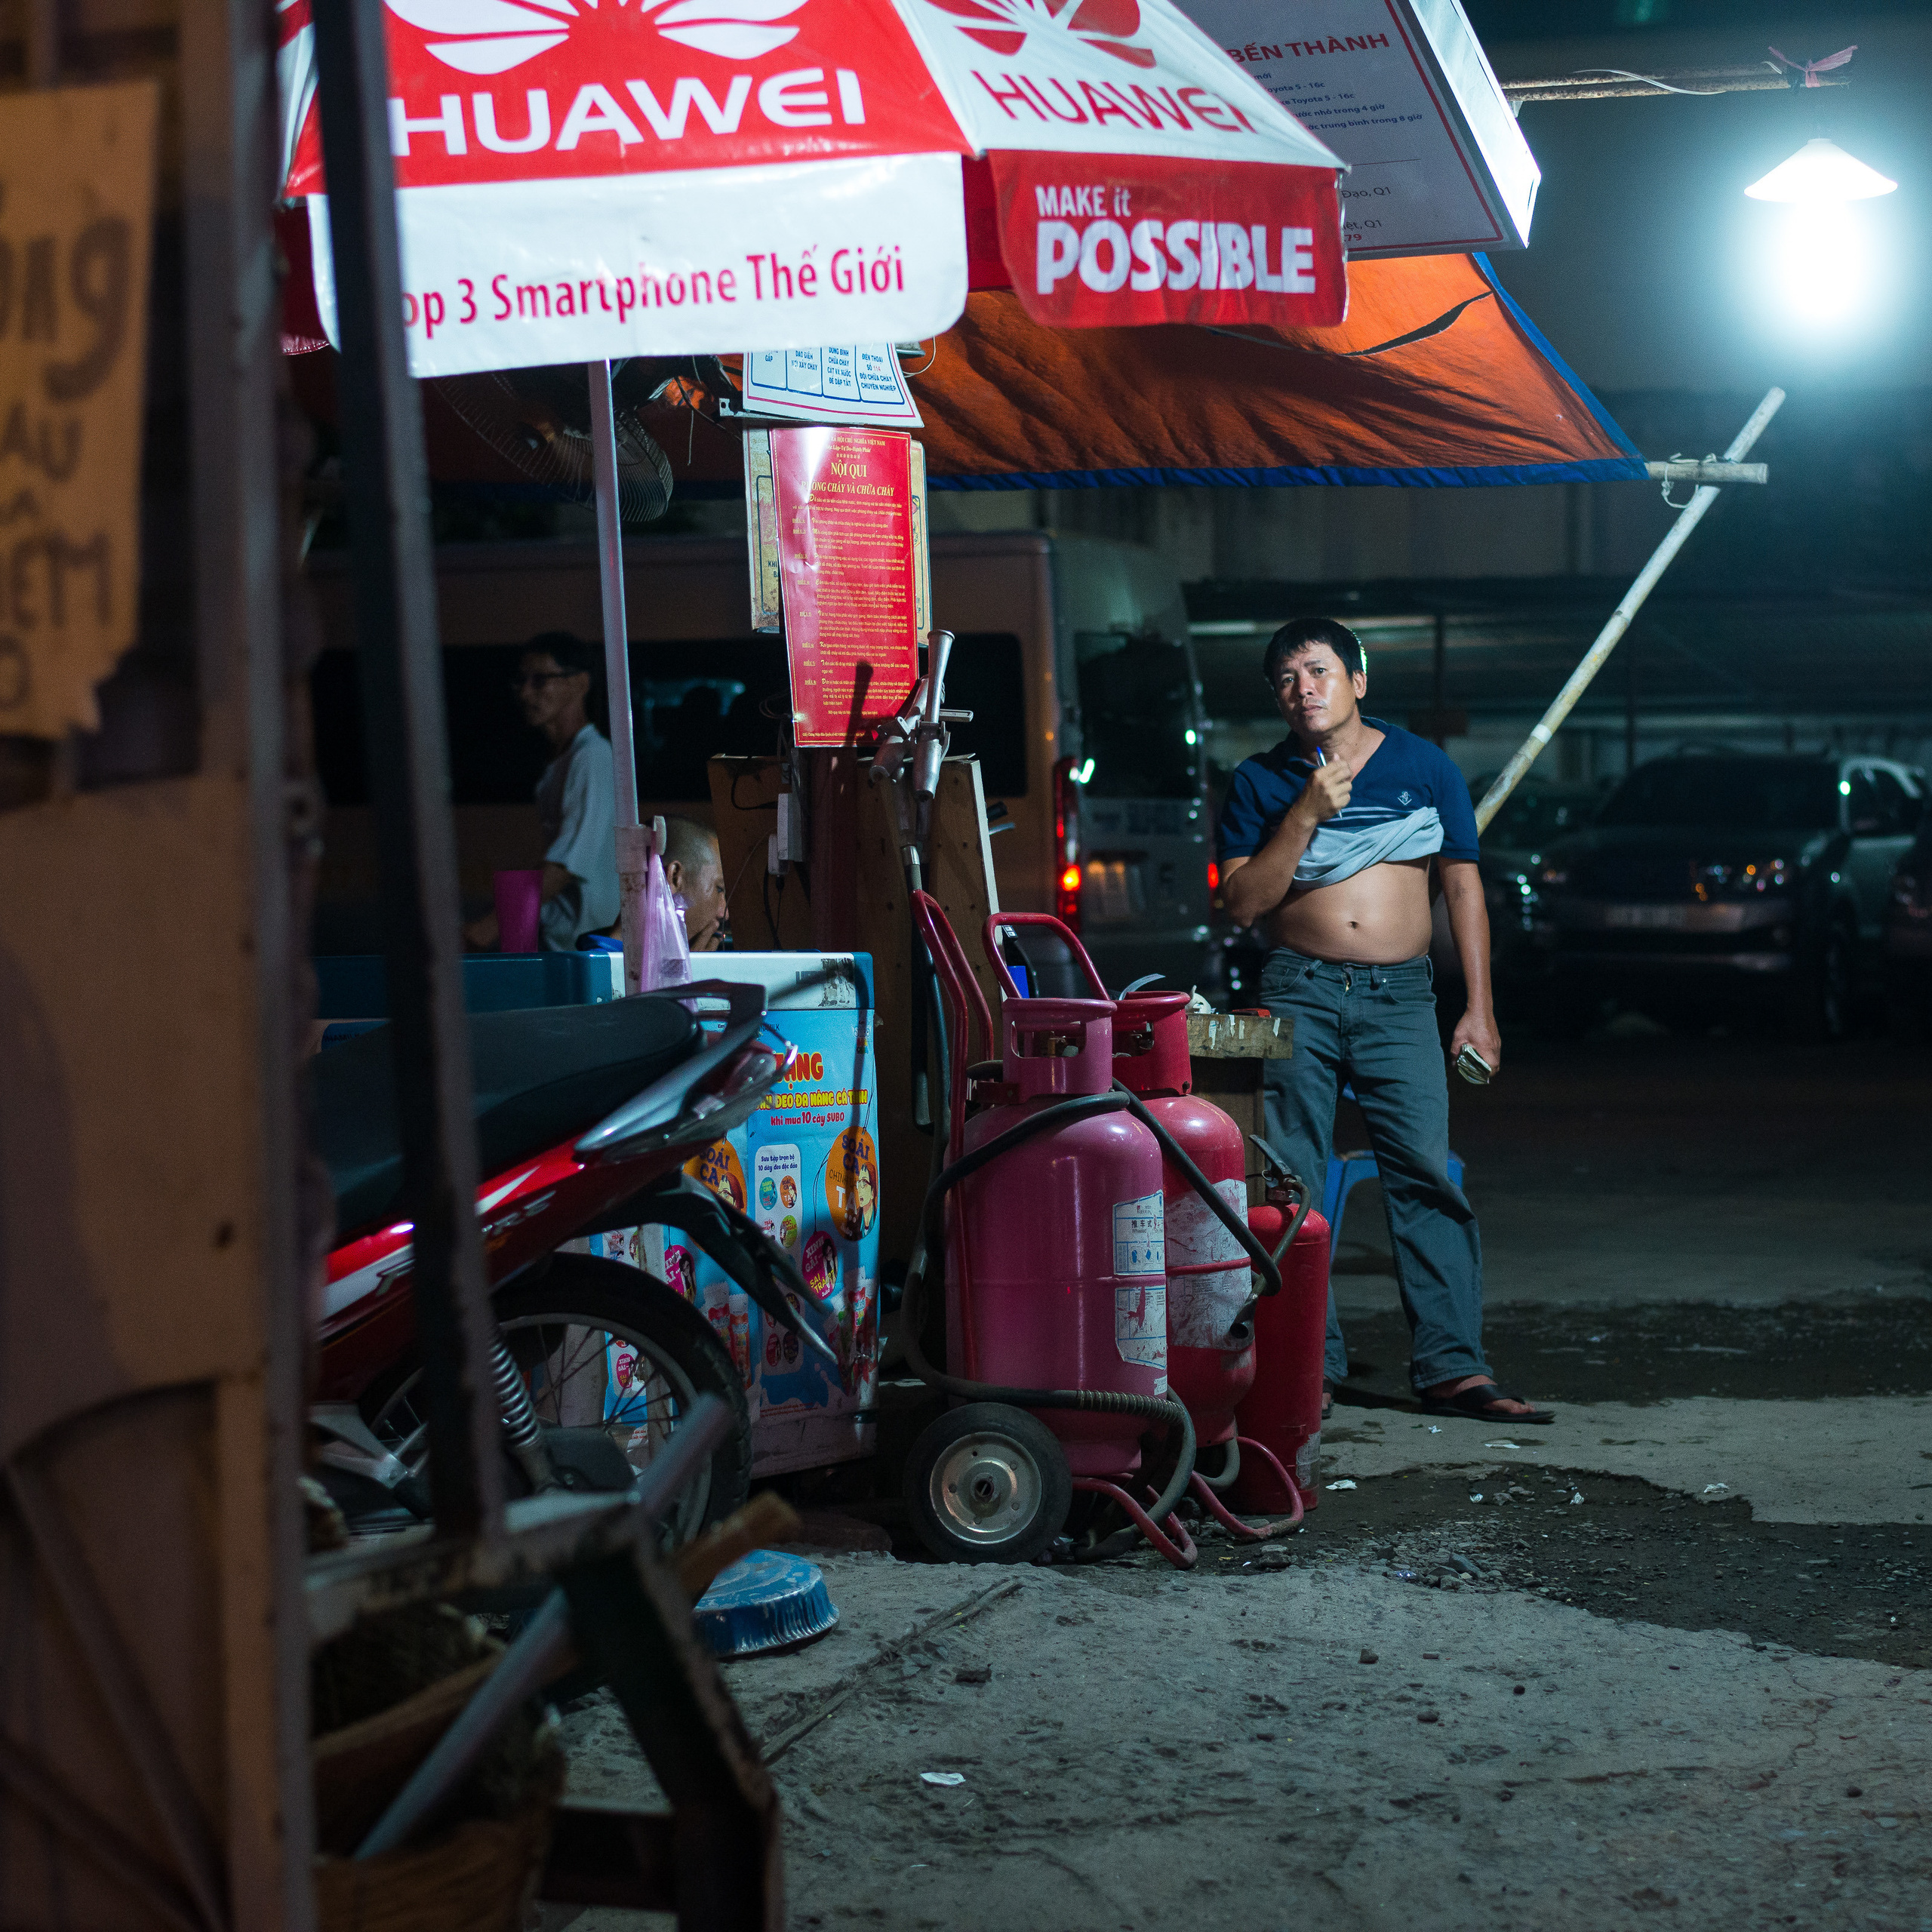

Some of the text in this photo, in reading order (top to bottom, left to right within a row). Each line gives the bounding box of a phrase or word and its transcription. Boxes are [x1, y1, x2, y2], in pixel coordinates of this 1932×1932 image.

[1285, 33, 1390, 57] THÀNH
[1268, 84, 1294, 94] oyota
[388, 68, 866, 157] HUAWEI
[971, 70, 1258, 134] HUAWEI
[1035, 184, 1132, 218] MAKE it
[1373, 186, 1391, 196] Q1
[1364, 220, 1383, 229] Q1
[1035, 219, 1316, 295] POSSIBLE
[403, 244, 906, 340] op 3 Smartphone Thế Giới
[831, 460, 867, 479] NỘI QUI
[827, 481, 845, 494] CHÁY
[847, 481, 855, 494] VÀ
[857, 483, 875, 496] CHỮA
[877, 485, 894, 497] CHÁY
[795, 1092, 809, 1108] ĐA
[835, 1087, 848, 1106] CÁ
[771, 1111, 844, 1127] khi mua 10 cây SUBO
[700, 1163, 718, 1187] CA
